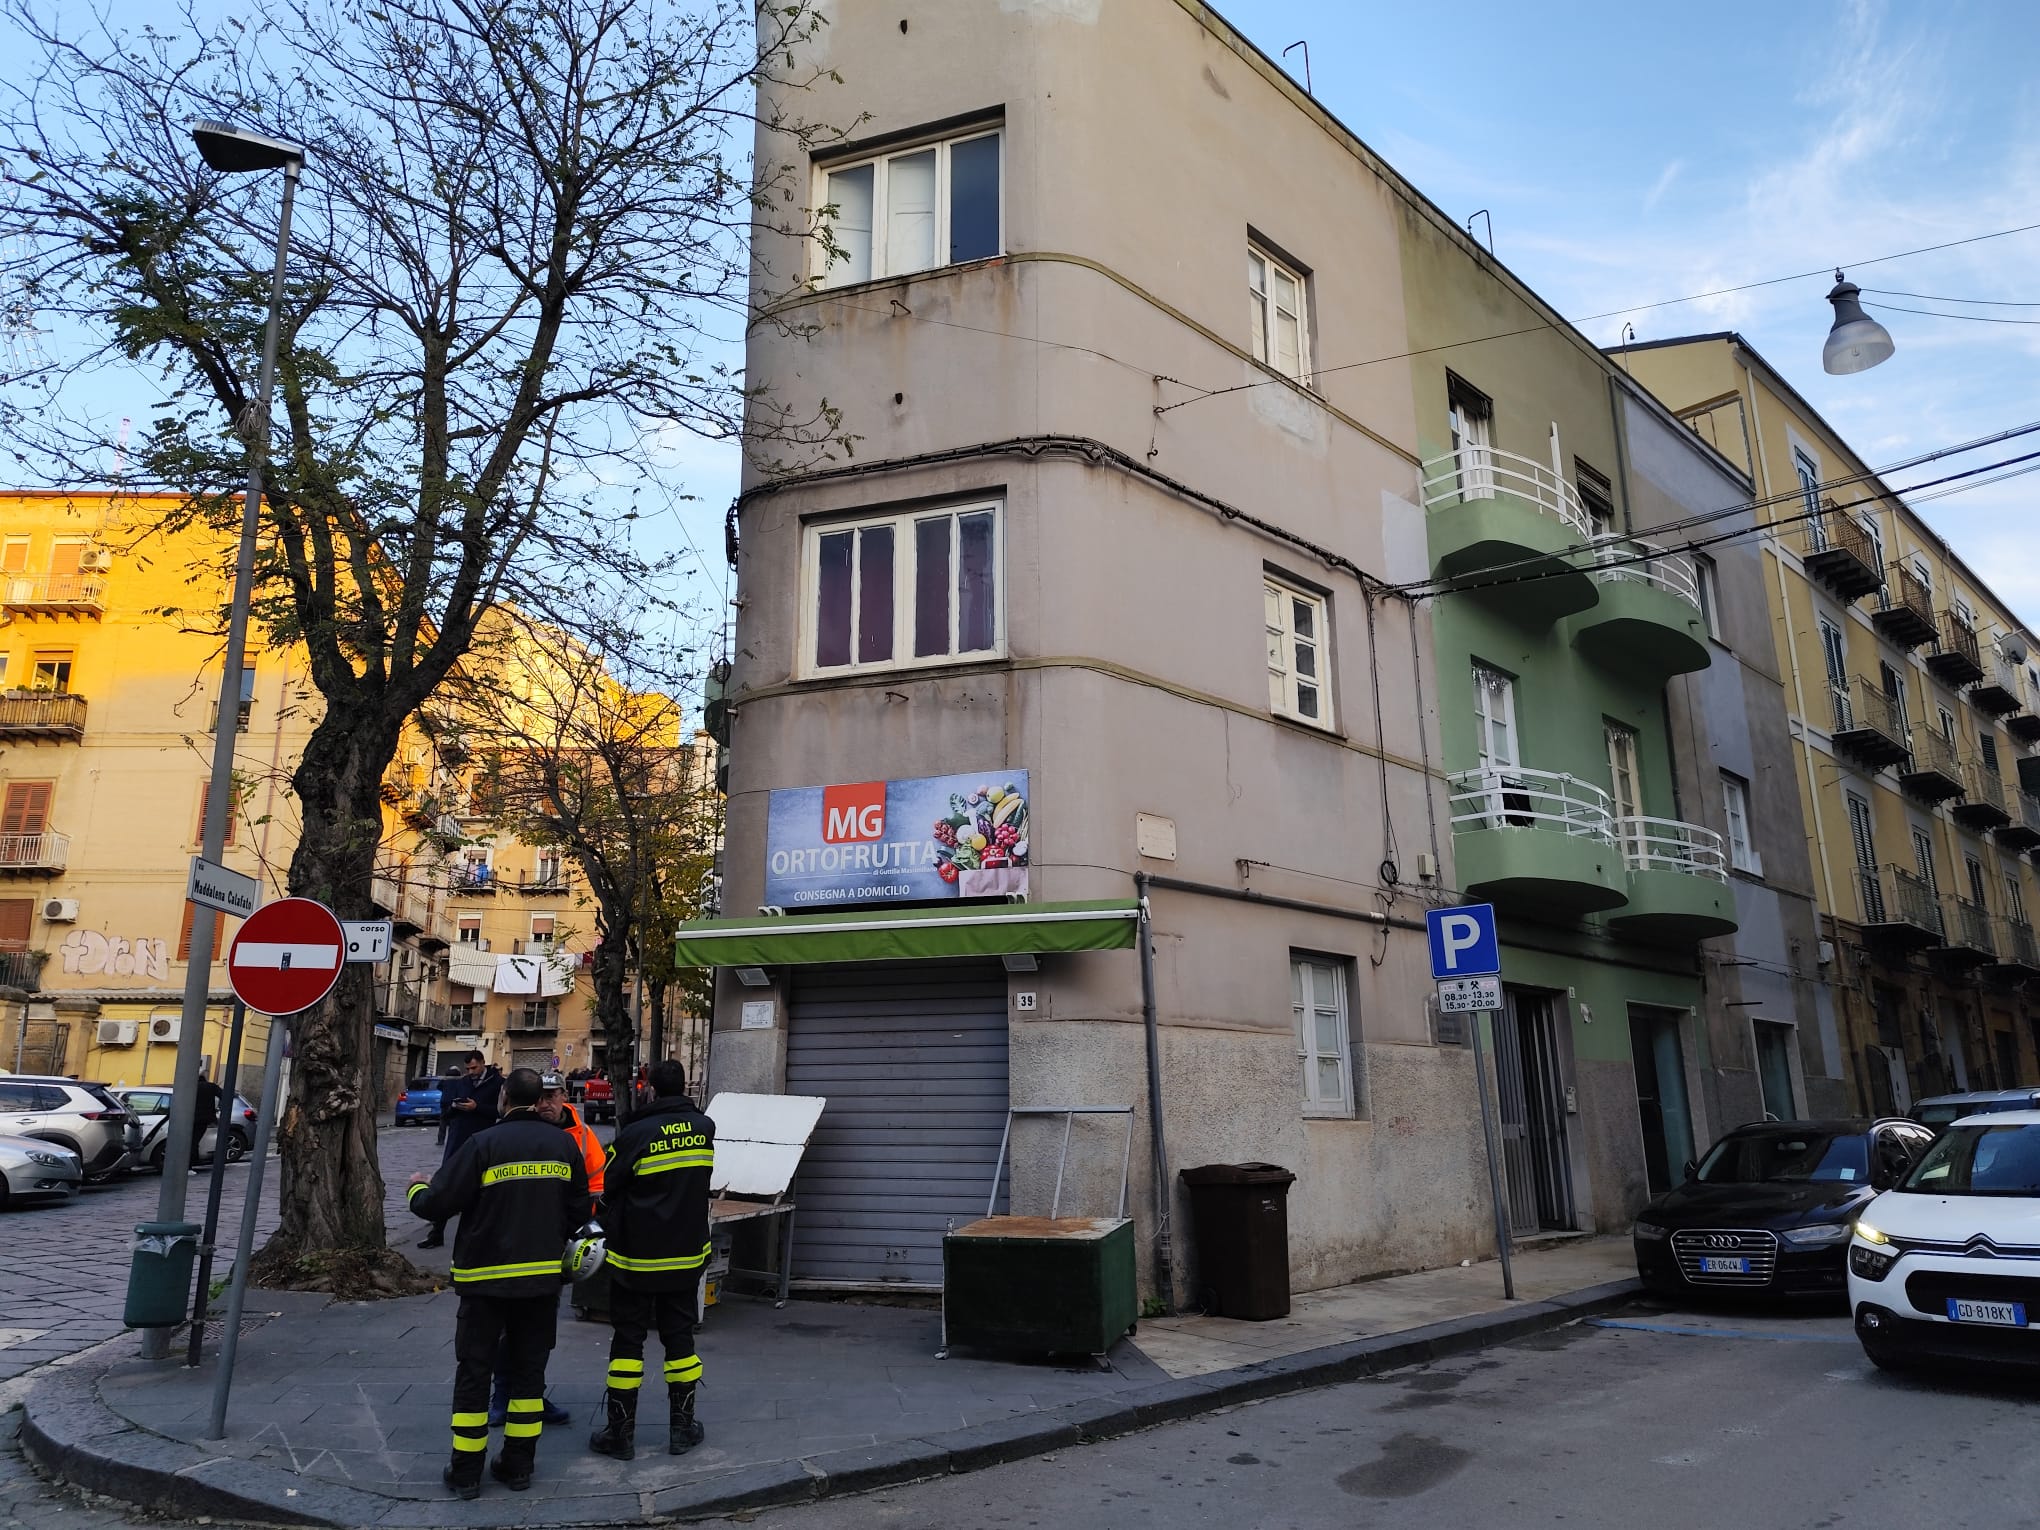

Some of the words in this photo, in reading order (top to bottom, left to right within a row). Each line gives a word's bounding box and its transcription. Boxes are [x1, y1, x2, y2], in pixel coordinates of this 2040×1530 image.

[826, 805, 882, 840] MG
[771, 840, 938, 875] ORTOFRUTTA
[194, 879, 225, 902] Maddalena
[227, 890, 252, 910] Calafato
[793, 887, 846, 901] CONSEGNA
[847, 887, 856, 898] A
[857, 884, 910, 898] DOMICILIO
[1441, 914, 1480, 969] P
[1021, 996, 1033, 1006] 39
[661, 1121, 692, 1136] VIGILI
[650, 1139, 670, 1153] DEL
[672, 1135, 706, 1149] FUOCO
[492, 1167, 518, 1179] VIGILI
[521, 1165, 537, 1175] DEL
